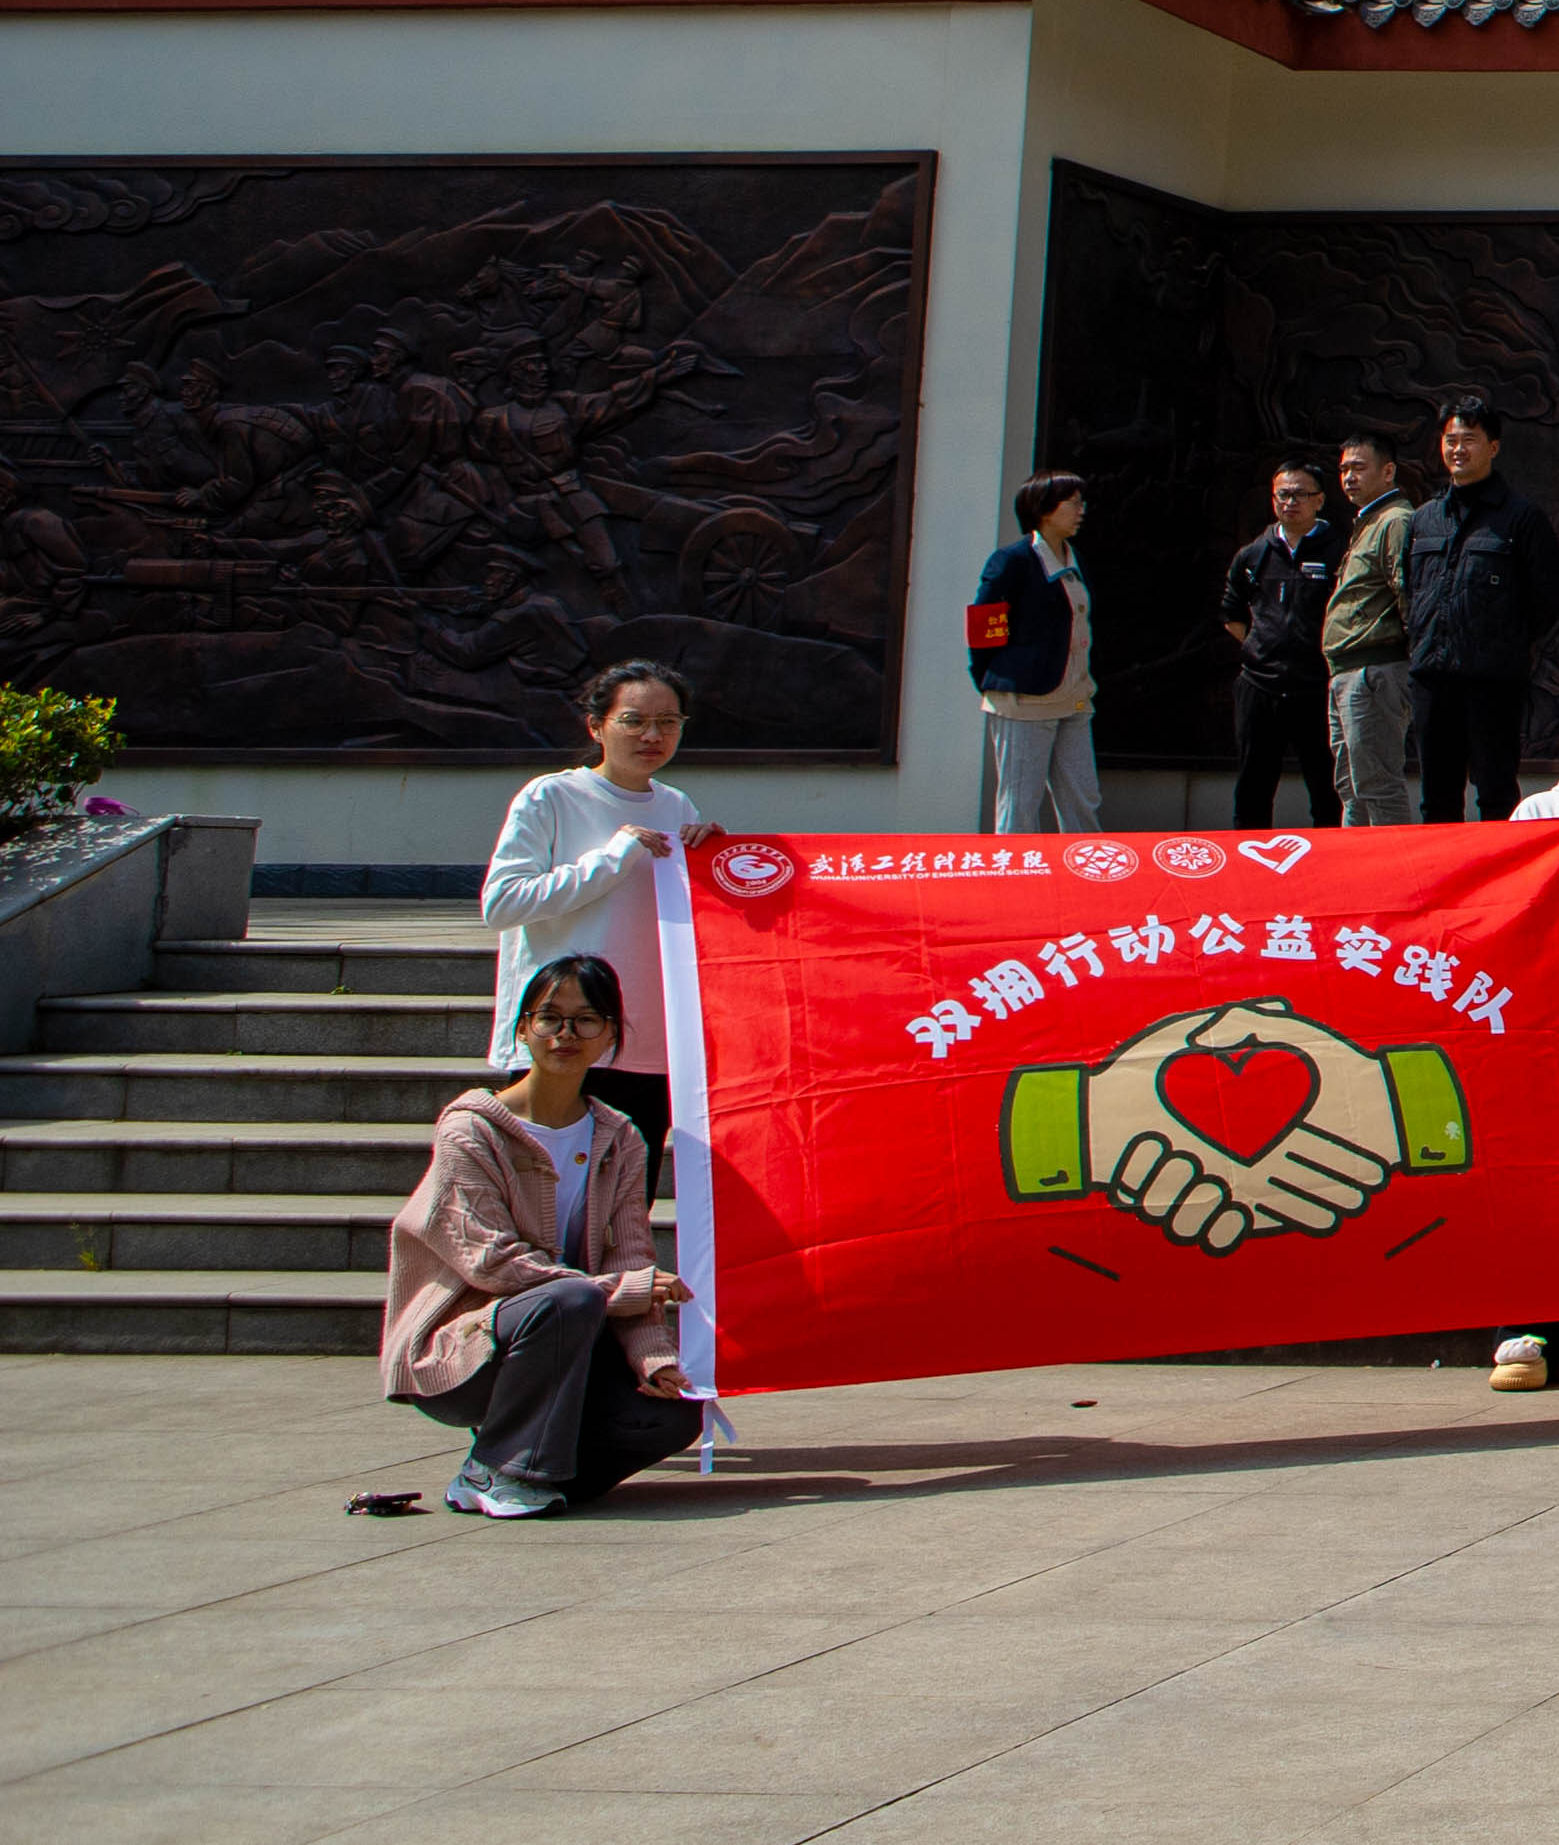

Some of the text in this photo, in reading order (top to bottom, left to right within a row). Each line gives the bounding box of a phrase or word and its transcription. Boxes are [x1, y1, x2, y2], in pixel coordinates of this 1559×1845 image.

[906, 912, 1513, 1061] 双拥行动公益实践队
